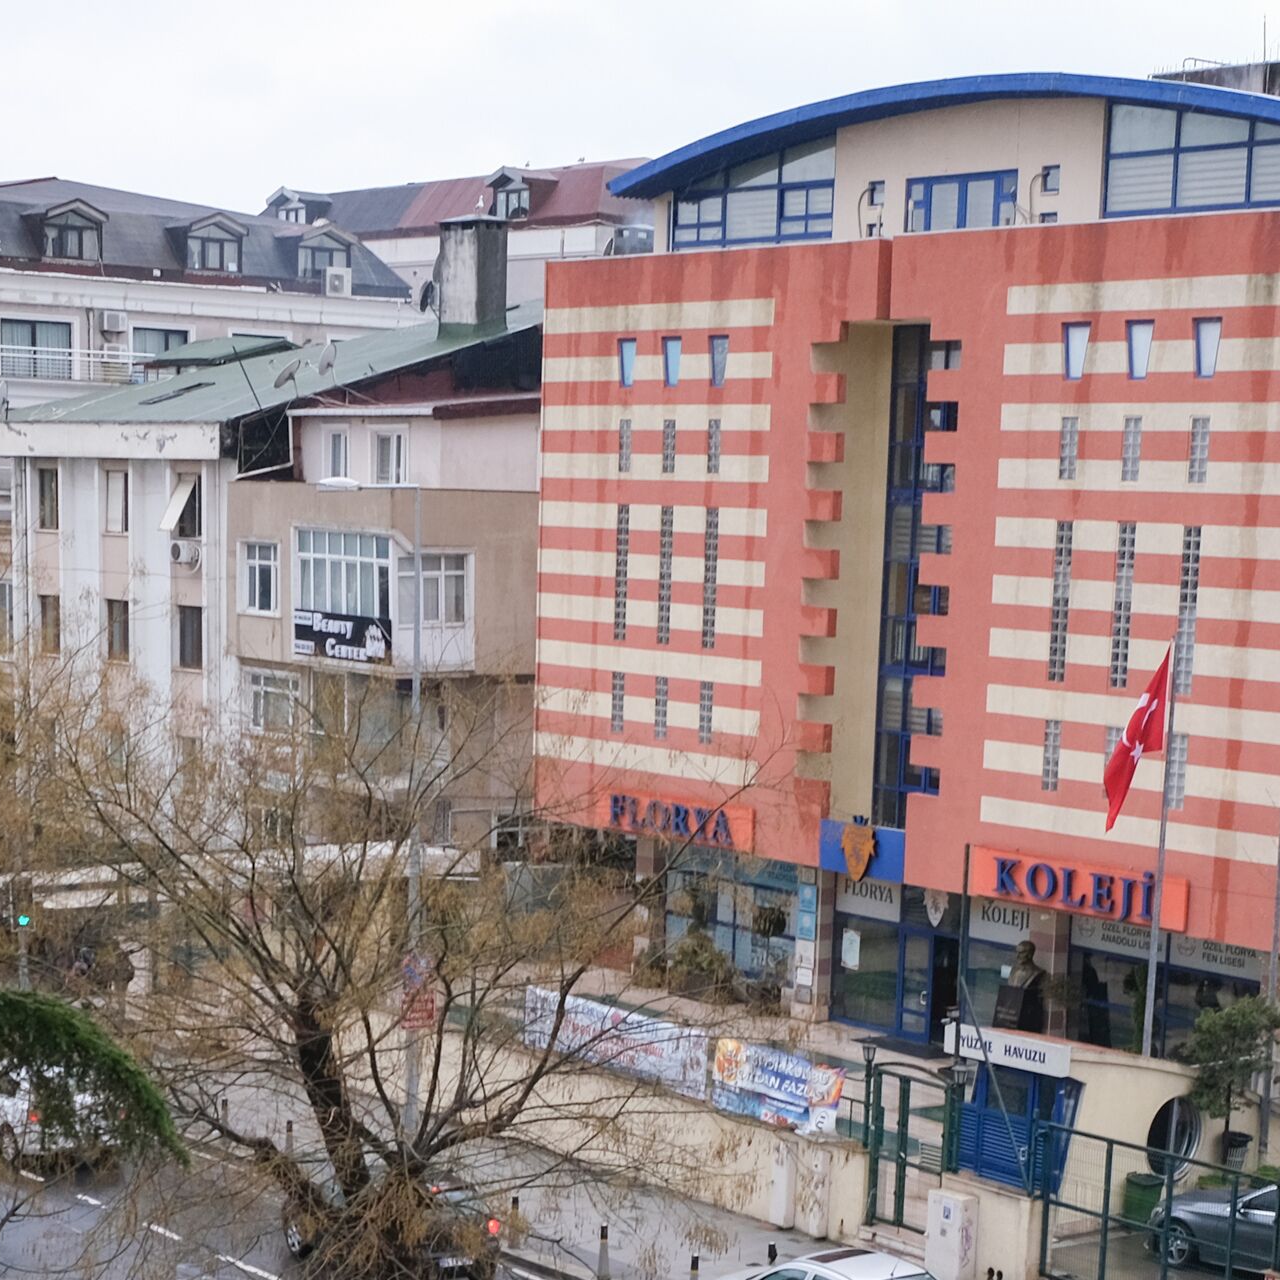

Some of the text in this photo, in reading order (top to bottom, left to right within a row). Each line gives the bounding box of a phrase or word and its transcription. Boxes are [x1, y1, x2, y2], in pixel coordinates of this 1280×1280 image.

[610, 794, 734, 846] FLORYA
[844, 877, 893, 904] FLORYA
[993, 856, 1156, 922] KOLEJİ
[1101, 932, 1137, 949] ANADOLU
[1203, 940, 1258, 959] ÖZEL FLORYA
[1202, 952, 1218, 963] FEN
[1004, 1044, 1046, 1064] HAVUZU
